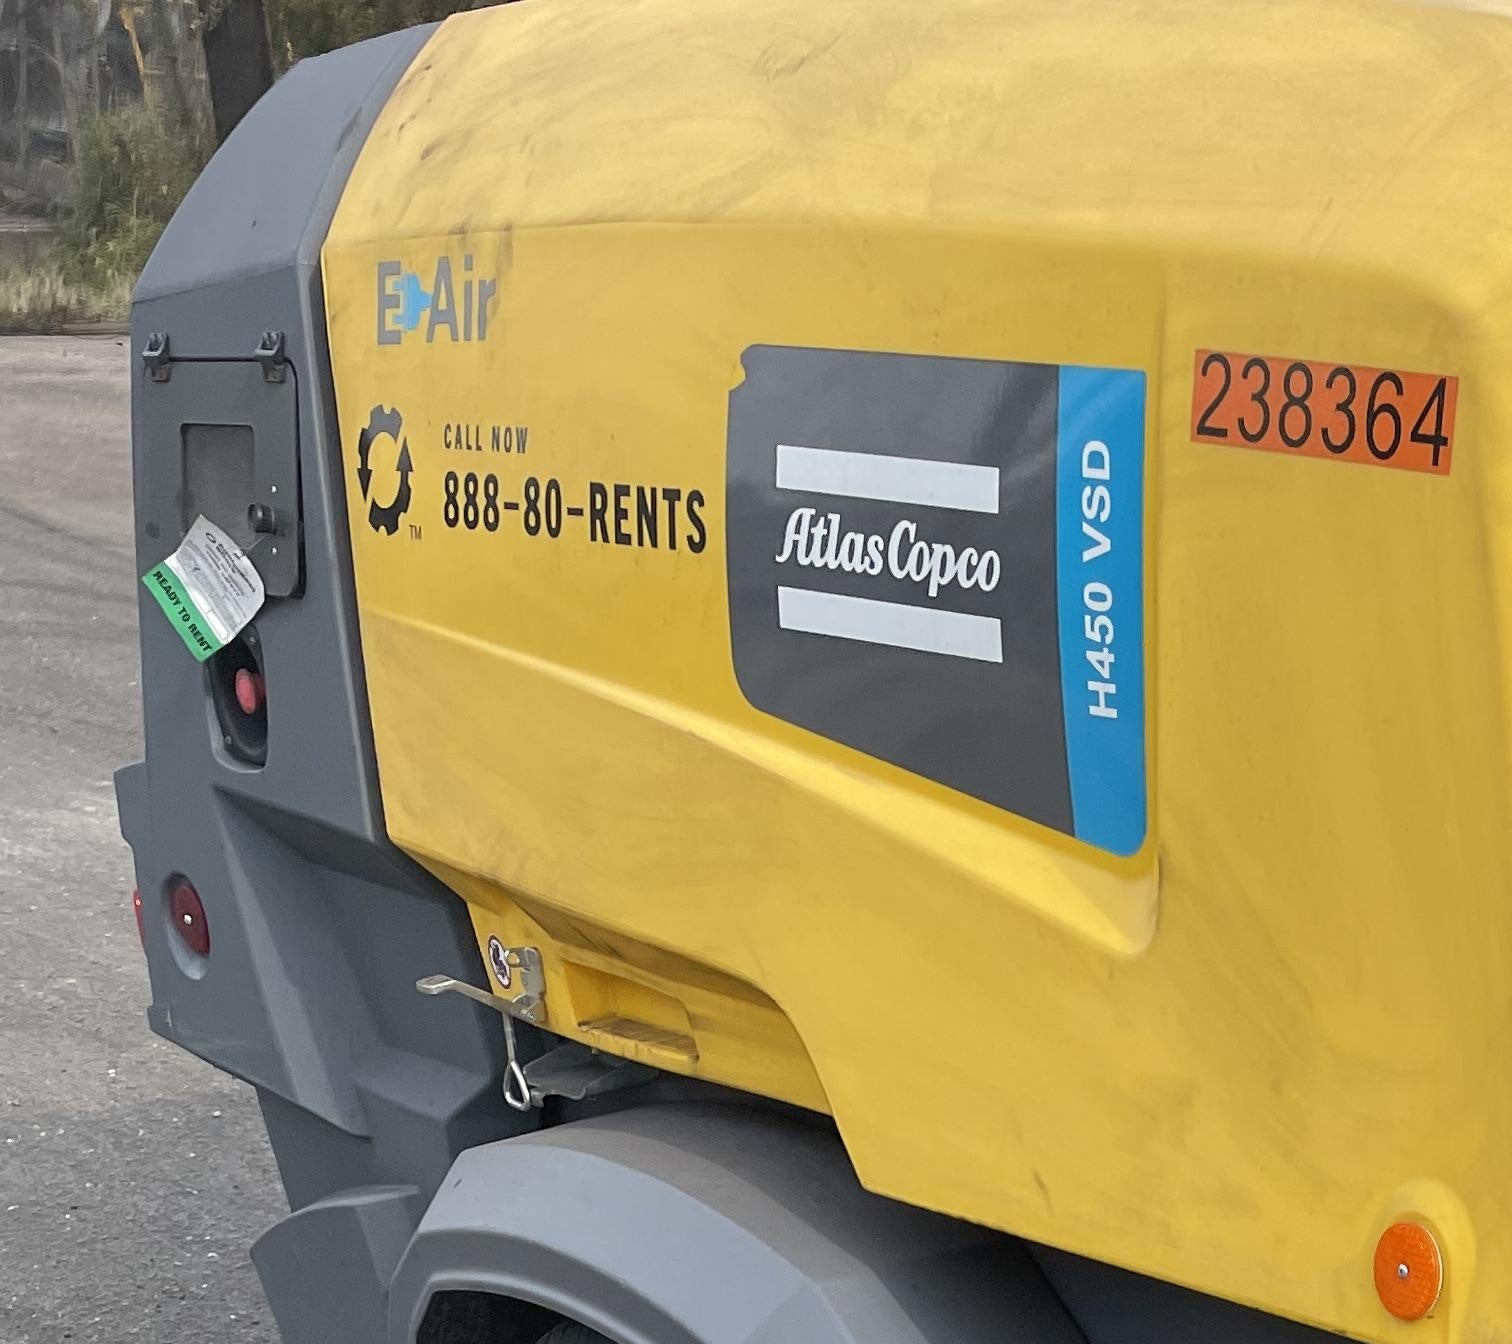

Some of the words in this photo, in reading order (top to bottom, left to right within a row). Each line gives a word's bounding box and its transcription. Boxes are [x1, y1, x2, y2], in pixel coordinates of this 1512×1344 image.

[444, 424, 482, 451] CALL
[491, 426, 528, 454] NOW
[1196, 353, 1449, 467] 238364
[444, 471, 706, 554] 888-80-RENTS
[1081, 440, 1111, 563] VSD
[775, 507, 885, 576] Atlas
[888, 519, 1001, 598] Copco
[153, 571, 181, 606] READY
[178, 606, 191, 623] TO
[188, 623, 212, 651] RENT
[1082, 582, 1118, 719] H450
